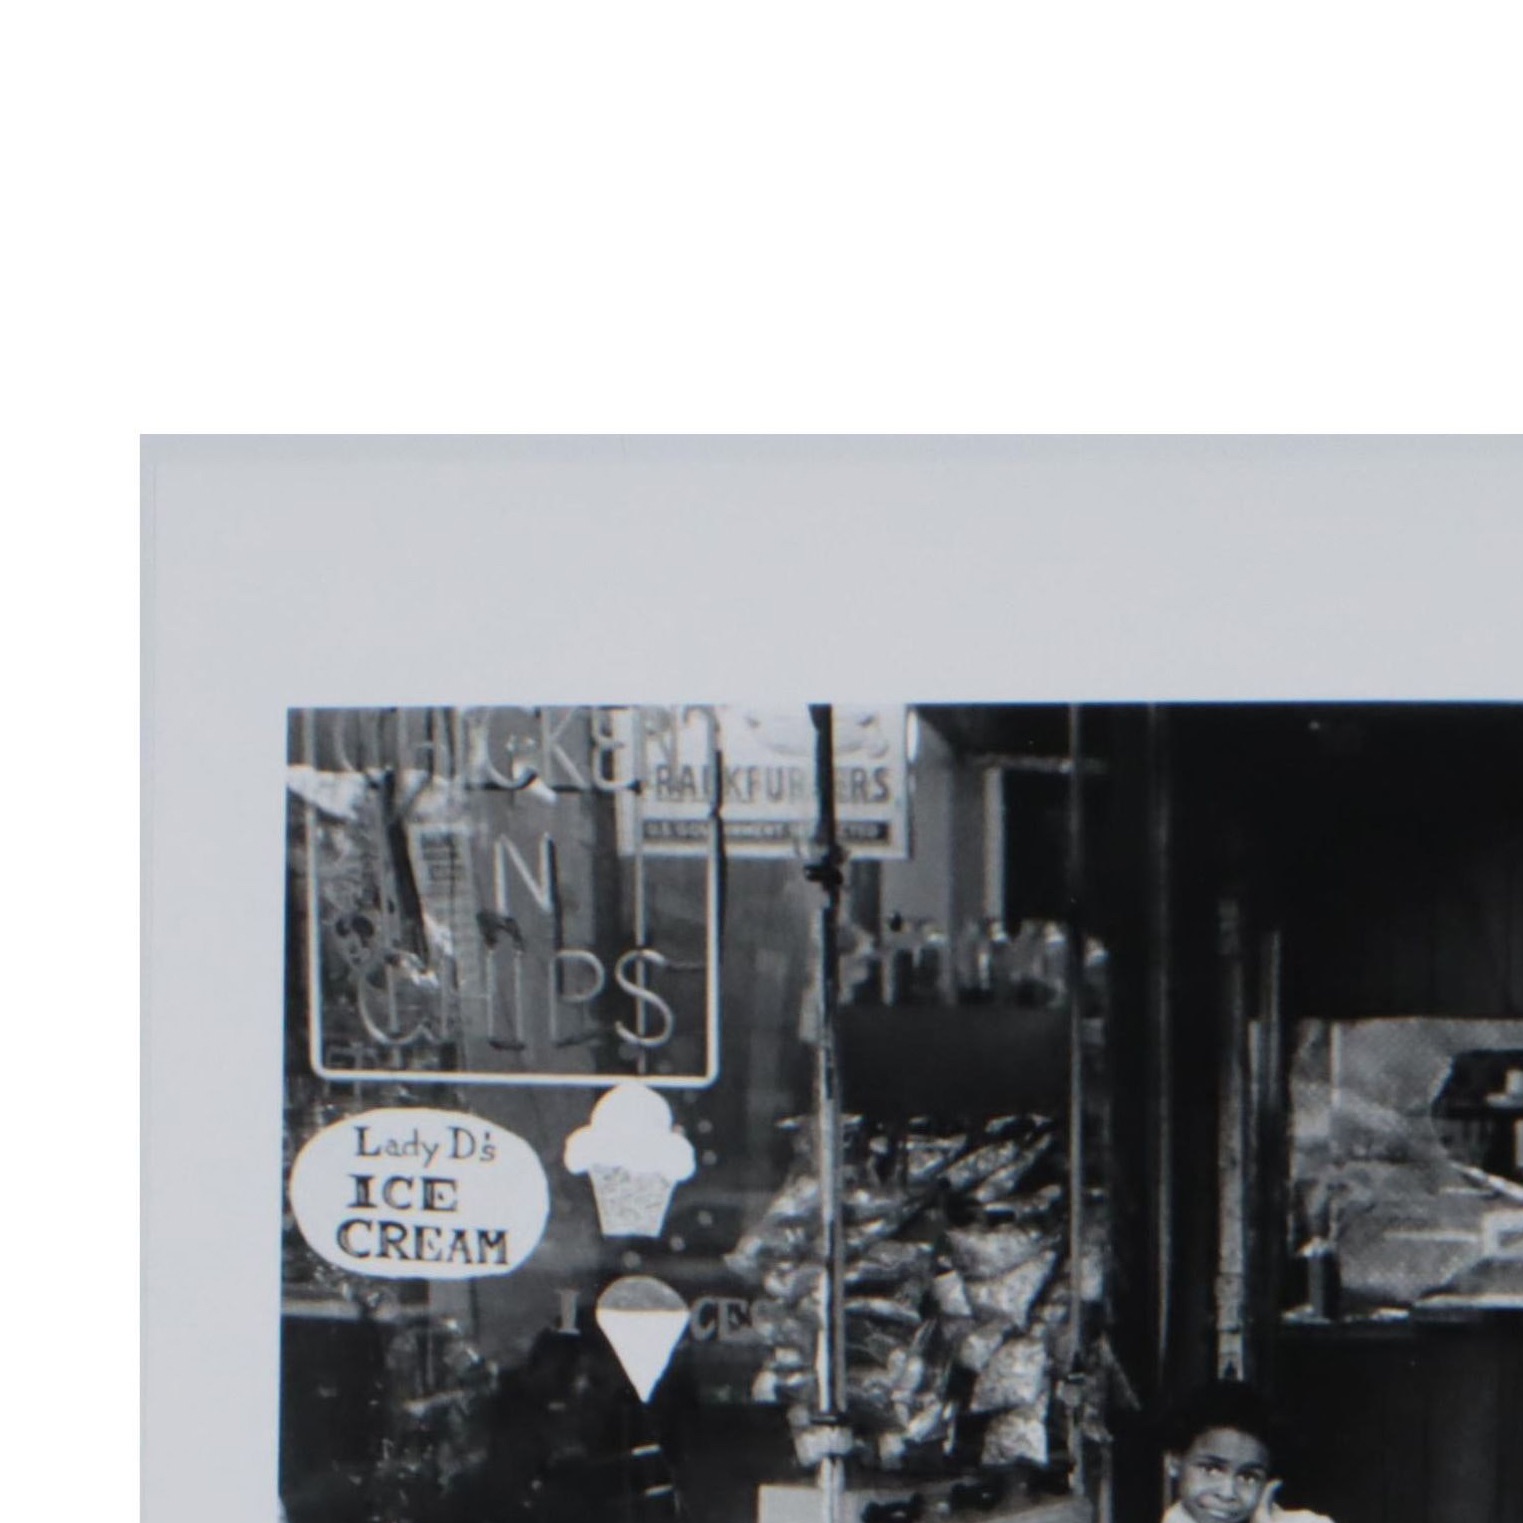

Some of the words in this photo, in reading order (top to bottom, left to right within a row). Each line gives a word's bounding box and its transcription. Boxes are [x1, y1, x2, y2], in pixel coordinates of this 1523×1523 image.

[496, 832, 552, 916] N
[358, 947, 674, 1048] CHIPS
[354, 1125, 440, 1169] Lady
[447, 1126, 497, 1163] D's
[347, 1174, 458, 1211] ICE
[336, 1219, 509, 1265] CREAM
